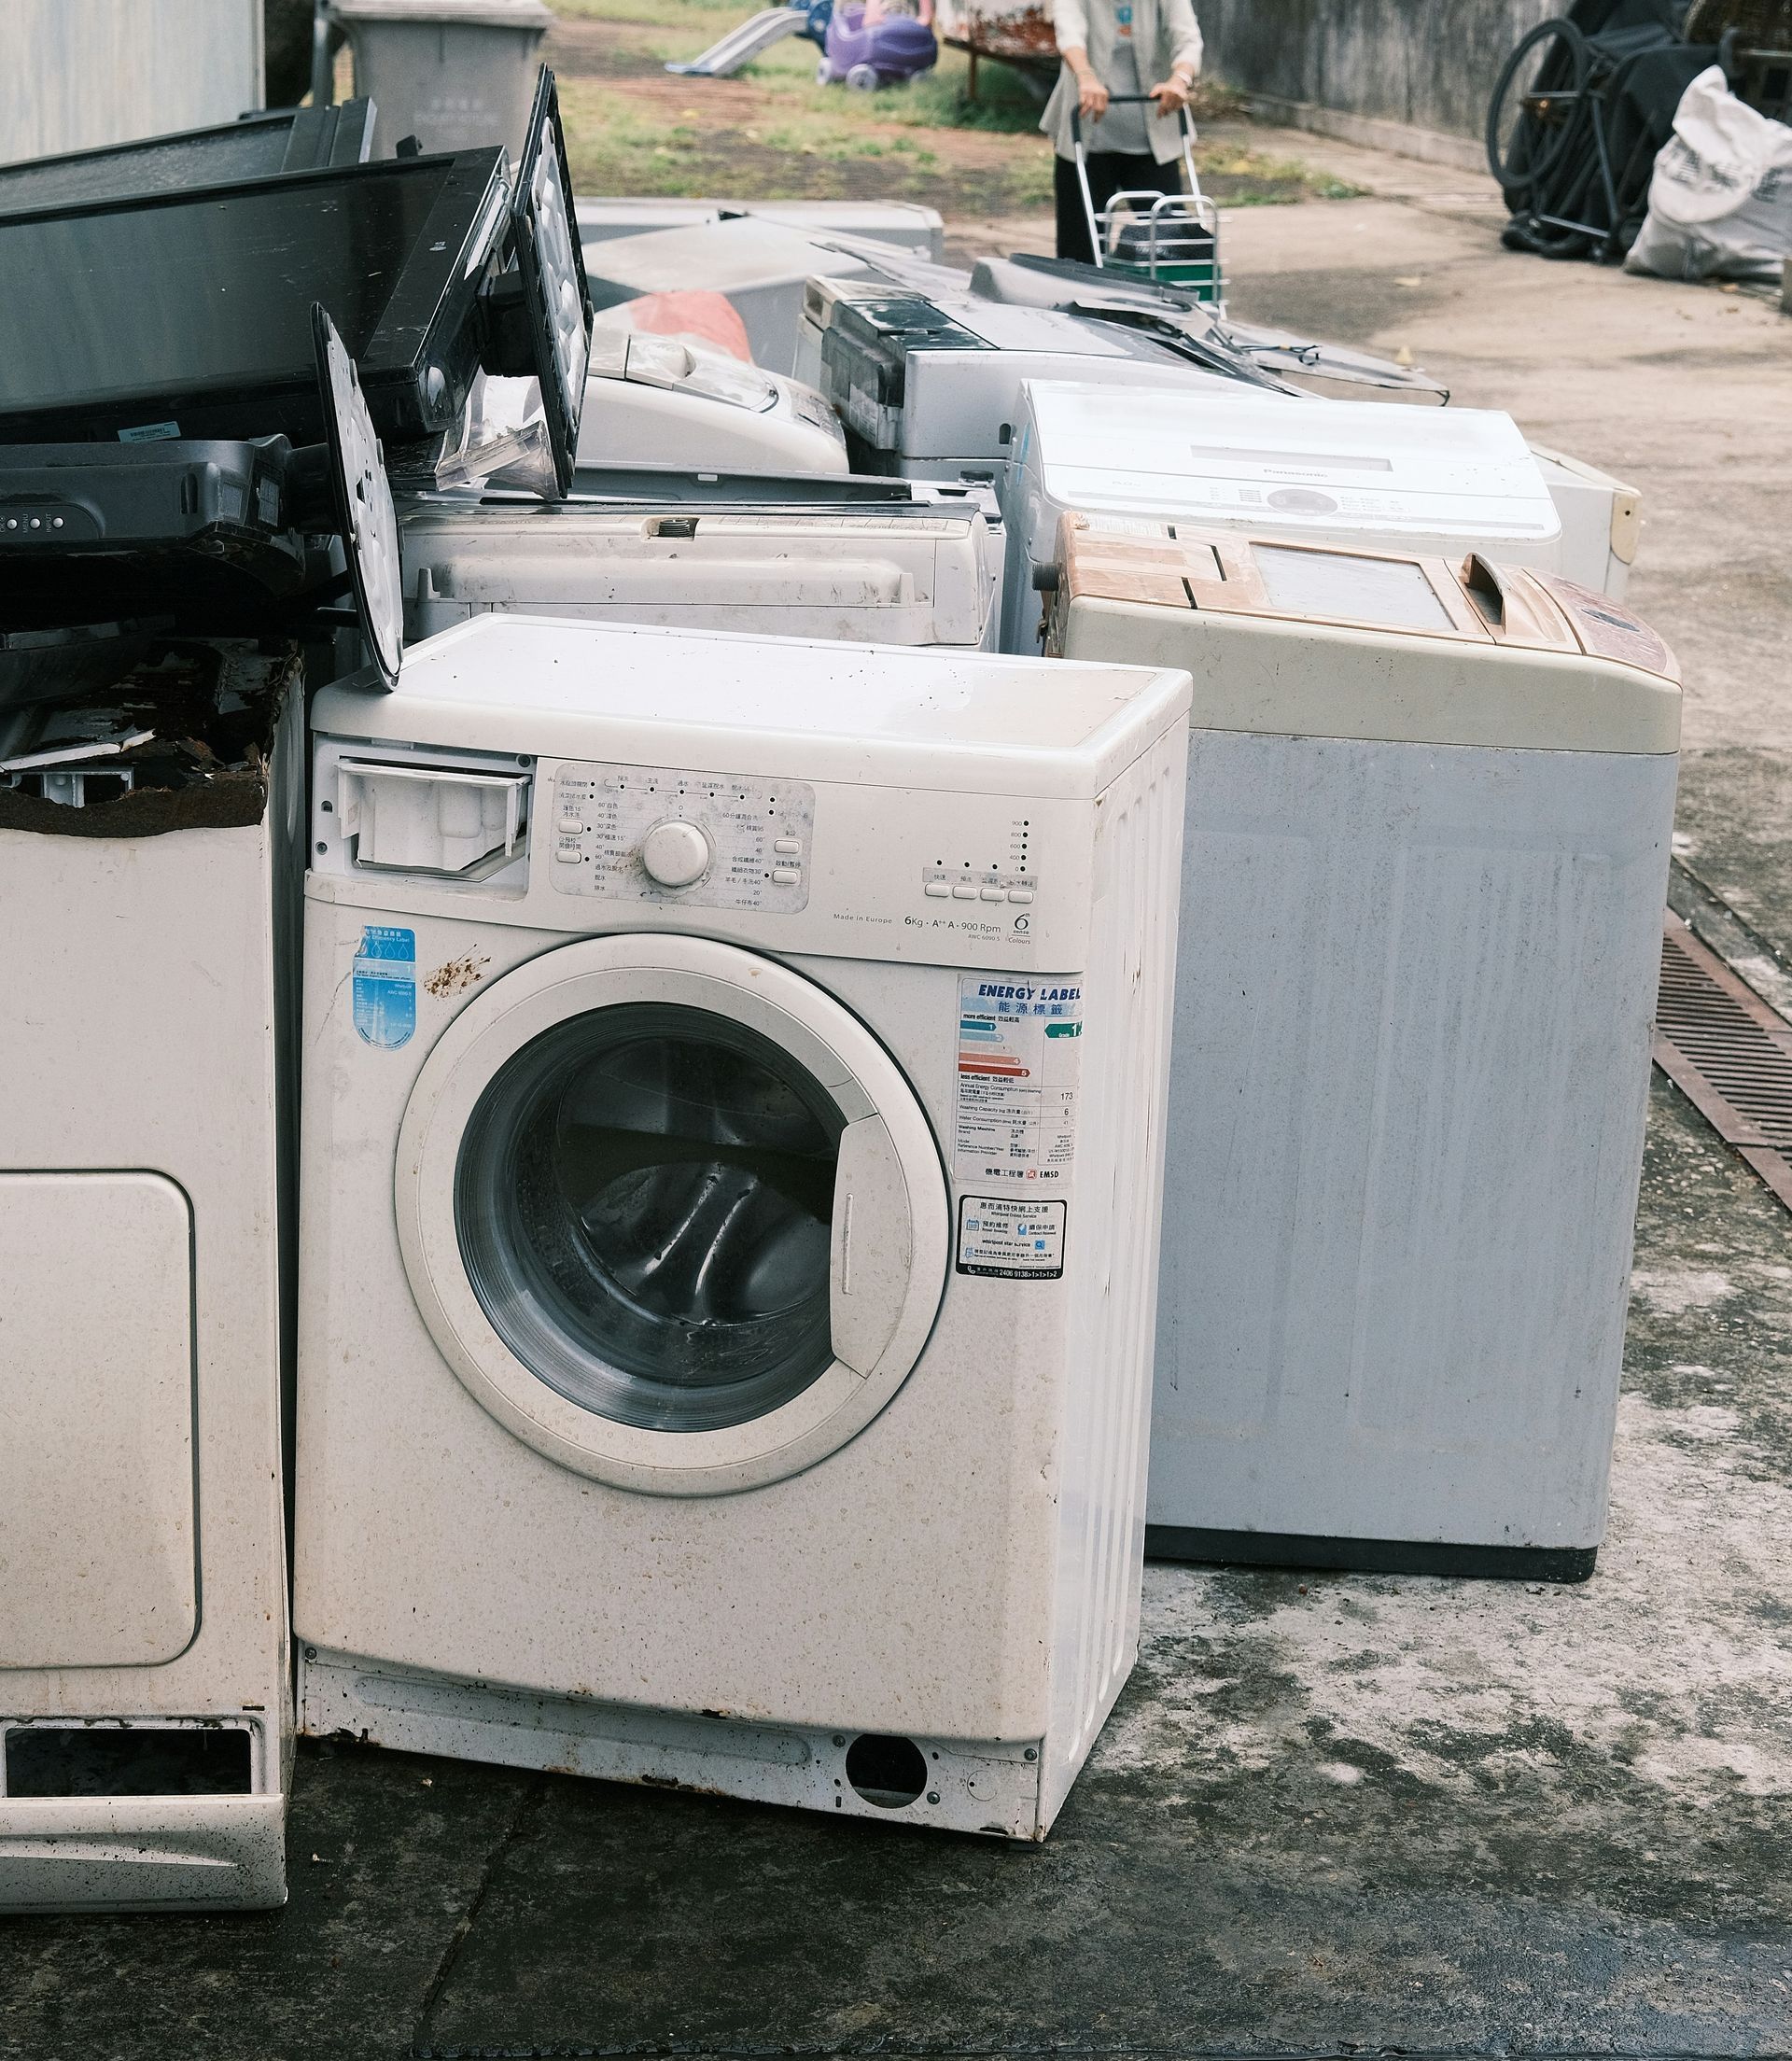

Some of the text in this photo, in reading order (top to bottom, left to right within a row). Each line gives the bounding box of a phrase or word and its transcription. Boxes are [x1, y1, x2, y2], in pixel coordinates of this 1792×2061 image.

[1263, 468, 1329, 479] Panasonic
[833, 913, 855, 921] Made
[866, 916, 892, 925] Europe
[904, 916, 923, 929] 6Kg
[947, 920, 955, 930] A
[961, 922, 978, 932] 900
[980, 922, 1001, 933] Rpm
[981, 933, 996, 942] 6090
[1008, 936, 1031, 945] Colours
[978, 984, 1081, 1001] ENERGY LABEL
[998, 1001, 1063, 1016] 能源標籤
[976, 1014, 996, 1022] efficient
[975, 1083, 989, 1091] Energy
[990, 1085, 1019, 1093] Consumption
[1060, 1091, 1073, 1101] 173
[1064, 1108, 1070, 1116] 6
[973, 1115, 1002, 1124] Consumption
[986, 1168, 1024, 1178] 機電工程署
[1040, 1170, 1059, 1179] EMSD
[980, 1202, 1049, 1213] 惠而浦特快網上支援
[999, 1269, 1014, 1277] 2406
